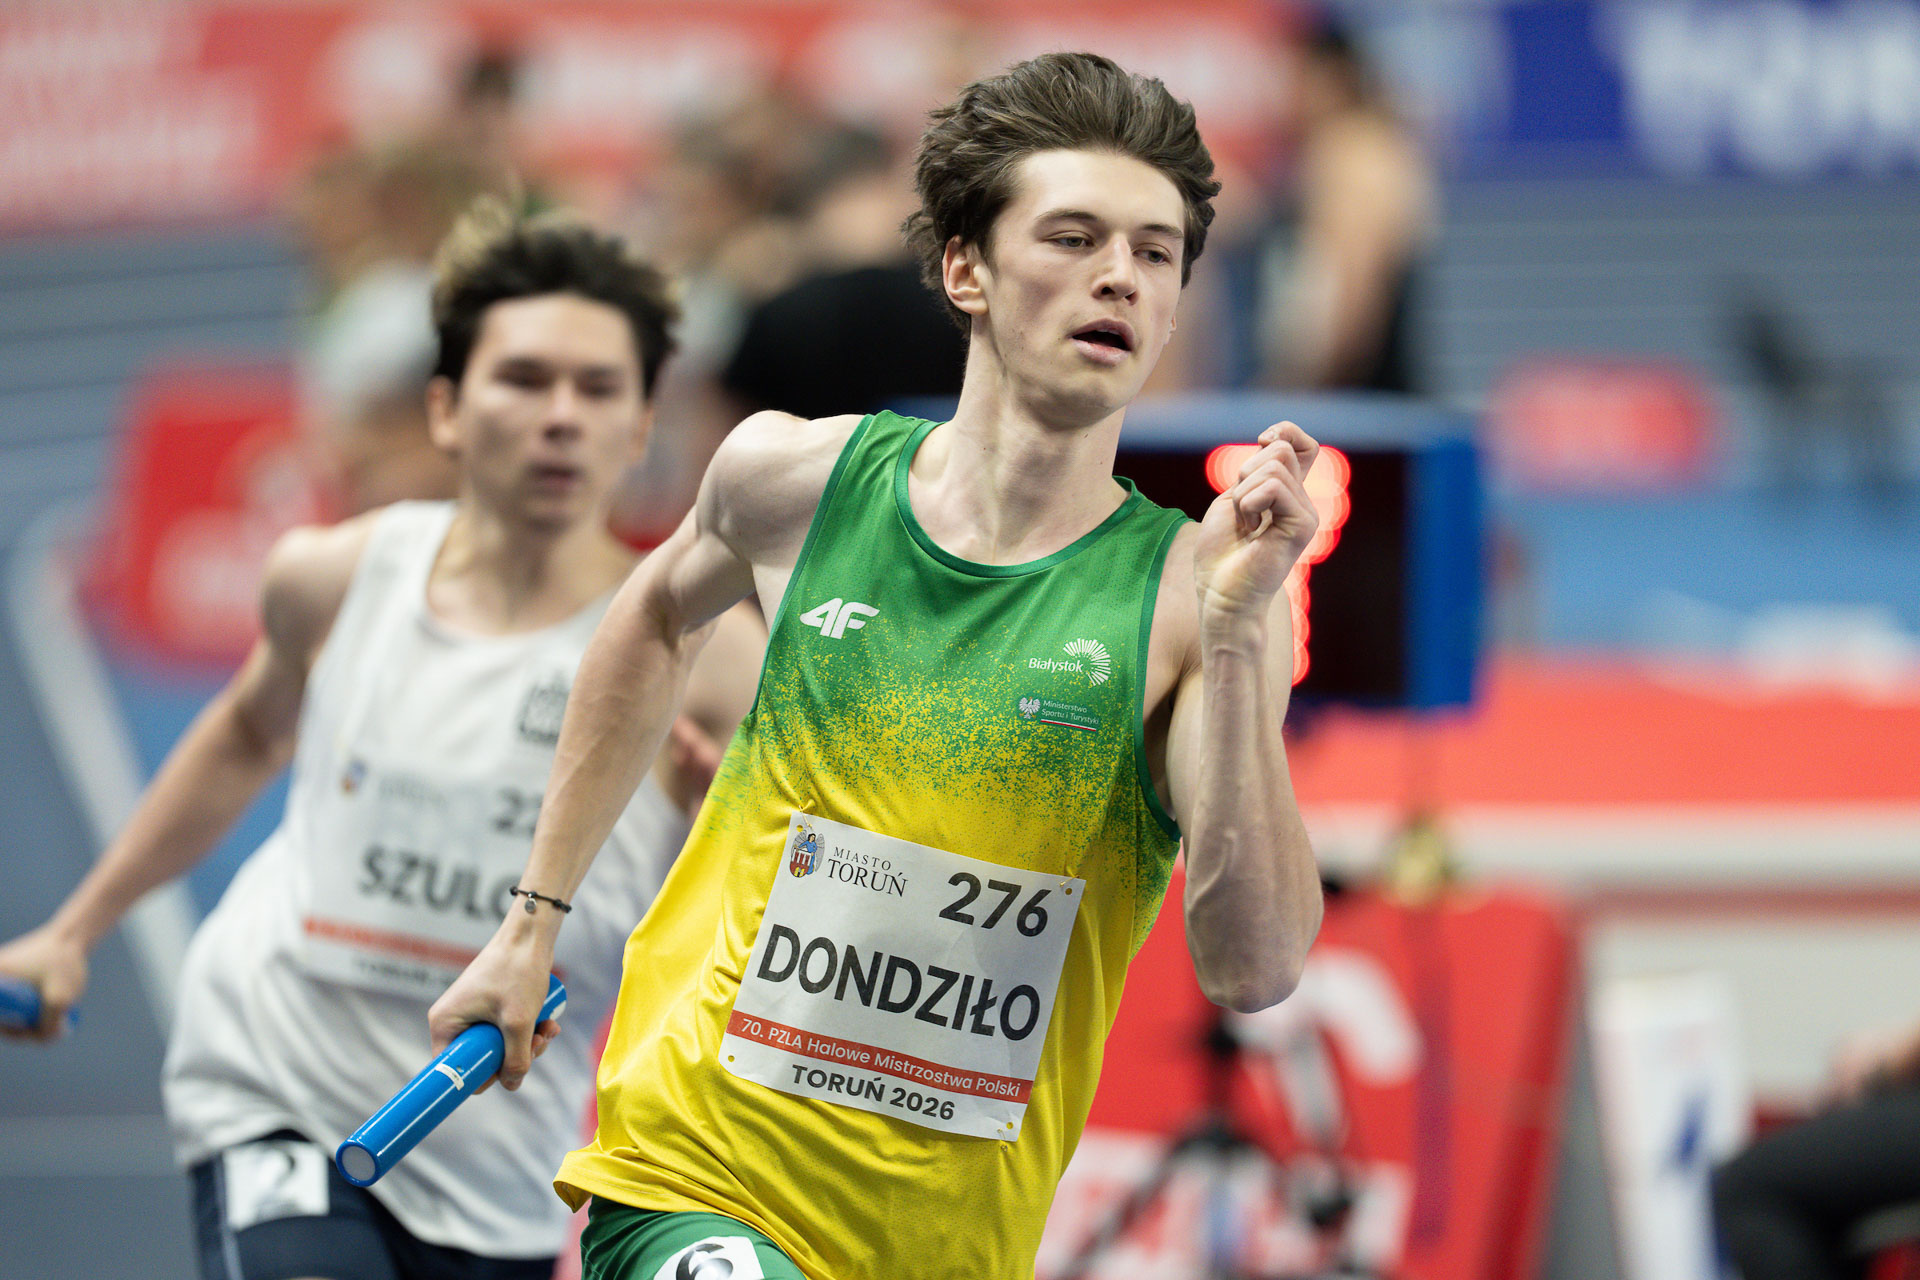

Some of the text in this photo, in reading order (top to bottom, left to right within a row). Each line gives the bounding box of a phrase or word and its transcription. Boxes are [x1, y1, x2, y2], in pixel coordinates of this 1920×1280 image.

[799, 597, 880, 640] 4F
[1028, 657, 1084, 674] Białystok
[1041, 708, 1066, 719] Sportu
[1070, 711, 1100, 725] Turystyki
[1043, 700, 1088, 714] Ministerstwo
[827, 857, 908, 897] TORUŃ
[833, 846, 892, 872] MIASTO
[938, 871, 1053, 938] 276
[756, 923, 1041, 1042] DONDZIŁO
[741, 1018, 1021, 1097] 70. PZLA Halowe Mistrzostwa Polski
[792, 1064, 956, 1121] TORUŃ 2026
